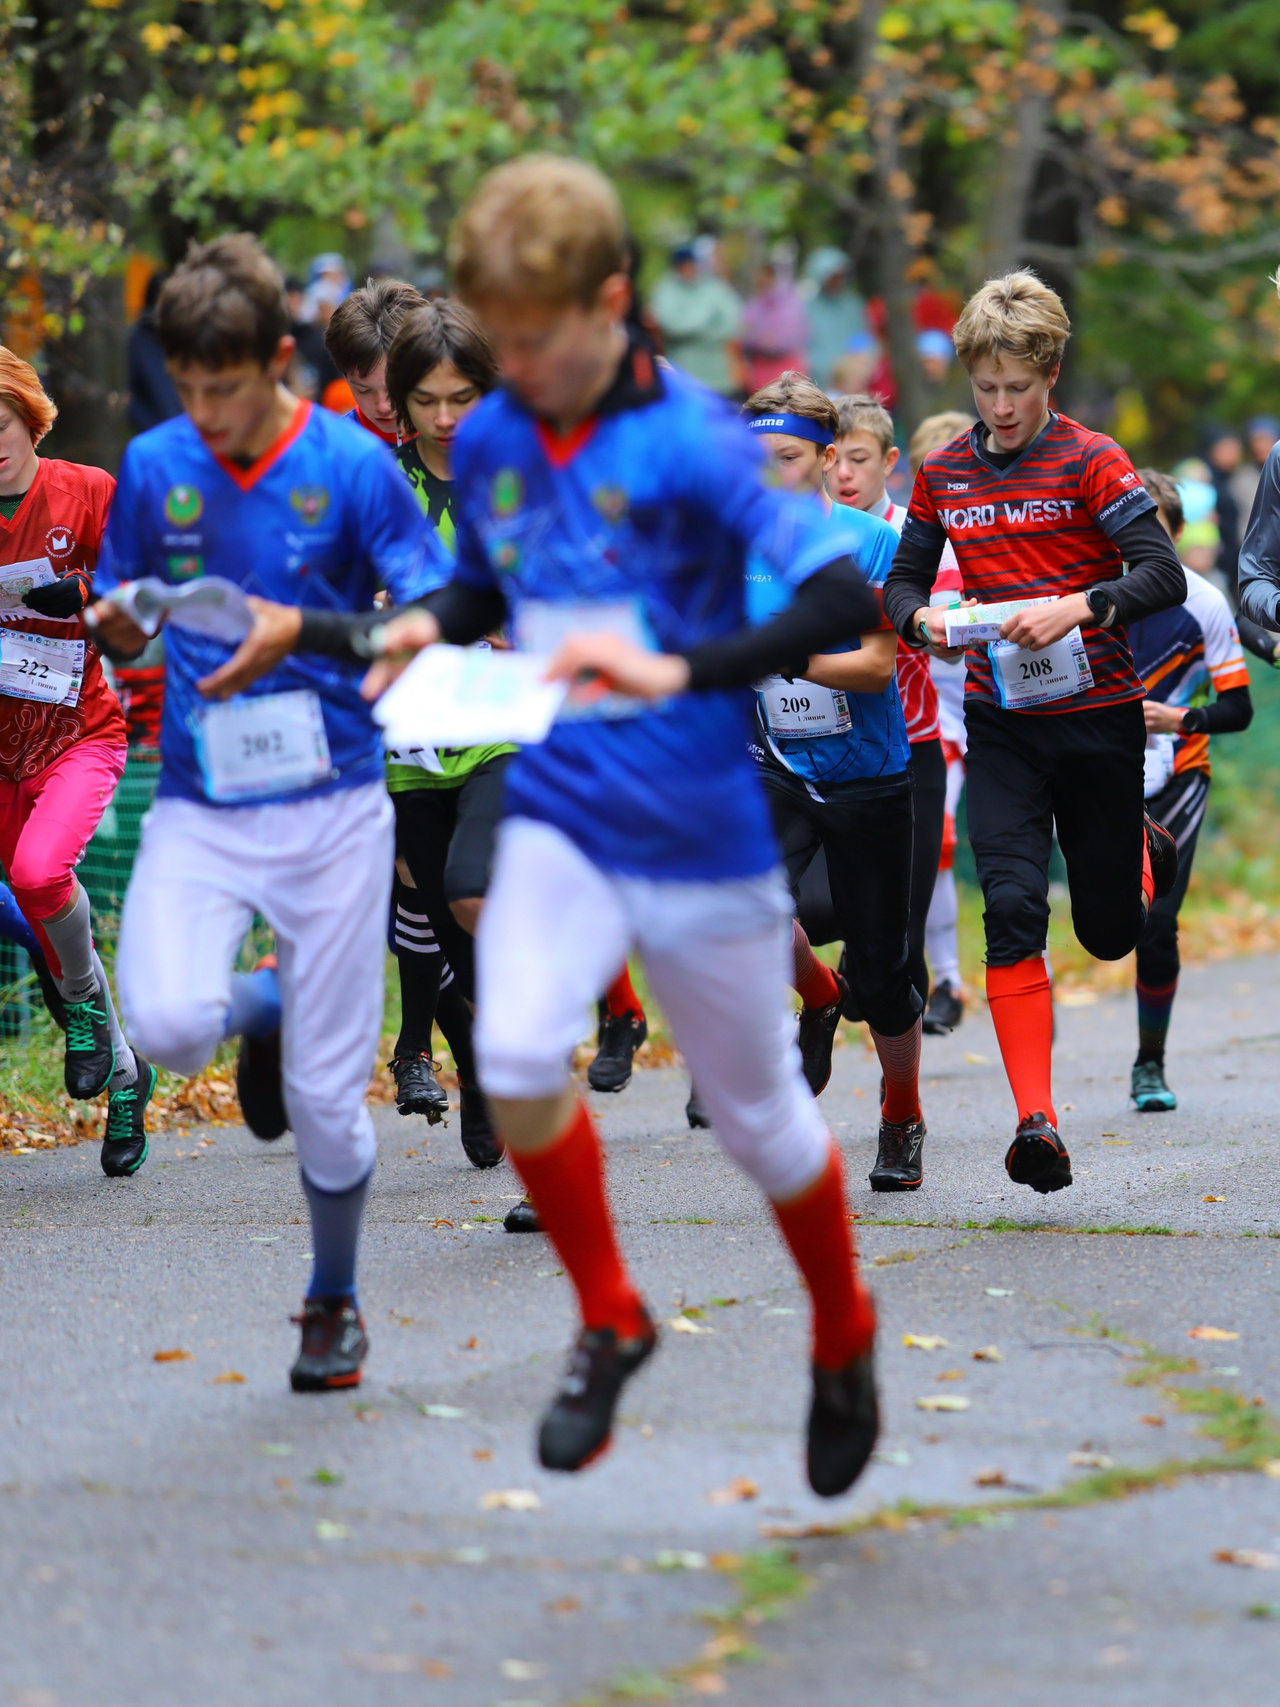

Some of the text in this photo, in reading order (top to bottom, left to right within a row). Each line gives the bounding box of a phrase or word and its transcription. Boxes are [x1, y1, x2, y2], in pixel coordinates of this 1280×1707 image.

[937, 499, 1076, 530] NORD WEST
[18, 658, 49, 679] 222
[1020, 658, 1052, 680] 208
[780, 697, 810, 713] 209
